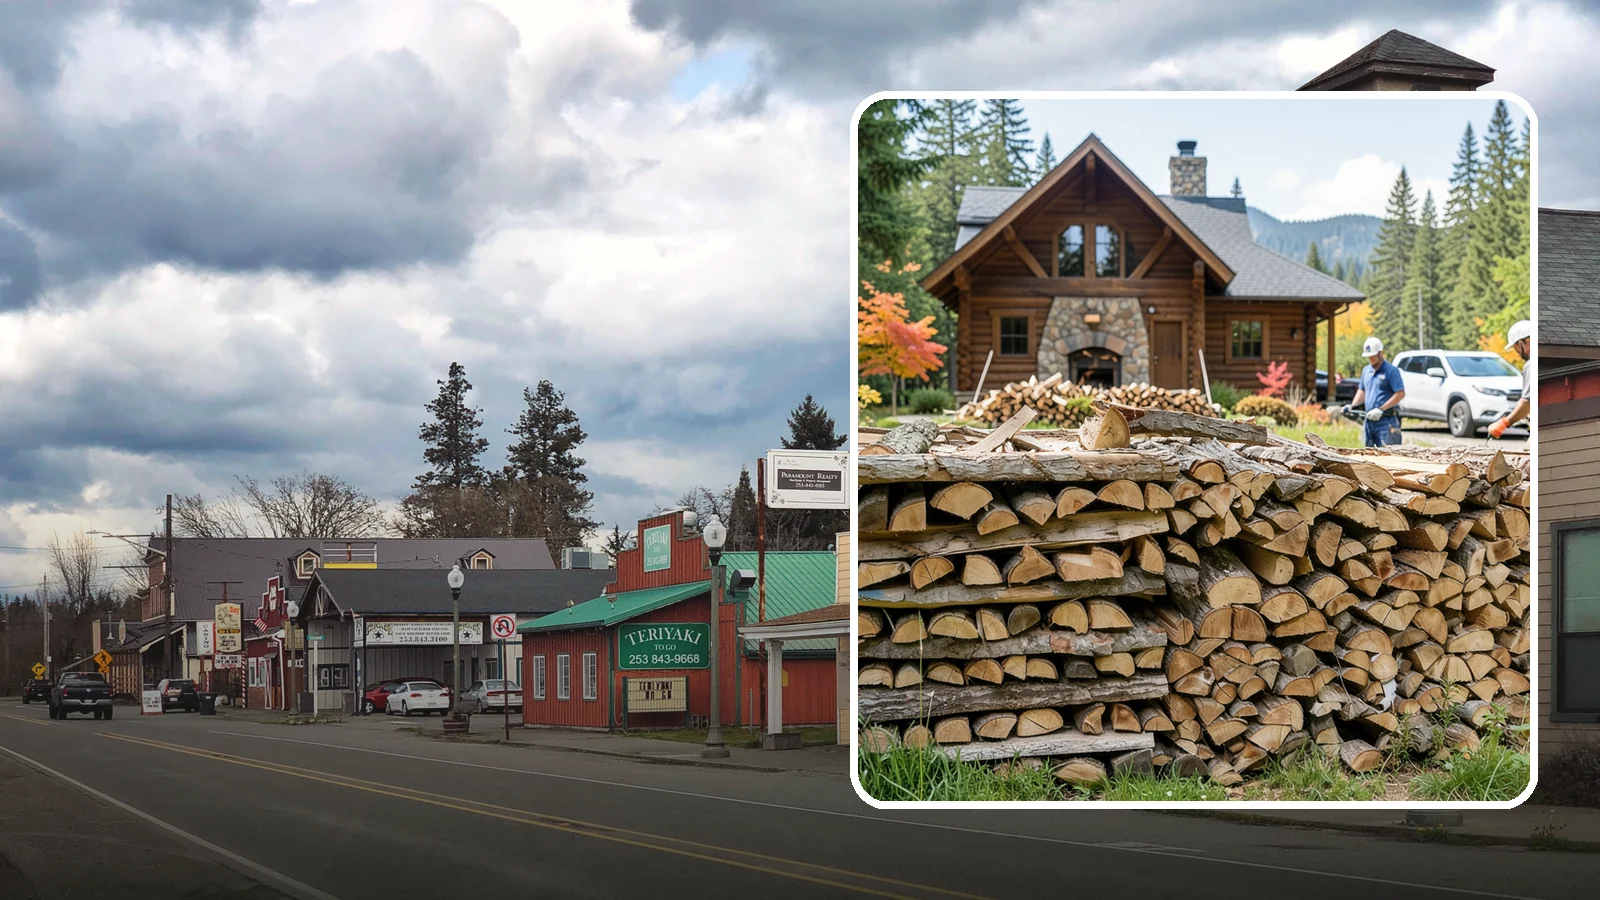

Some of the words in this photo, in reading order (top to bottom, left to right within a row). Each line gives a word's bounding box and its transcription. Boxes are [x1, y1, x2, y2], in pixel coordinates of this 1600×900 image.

[625, 627, 702, 646] TERIYAKI
[653, 643, 665, 651] TO
[665, 643, 677, 651] GO
[628, 654, 648, 665] 253
[651, 653, 700, 664] 843-9668
